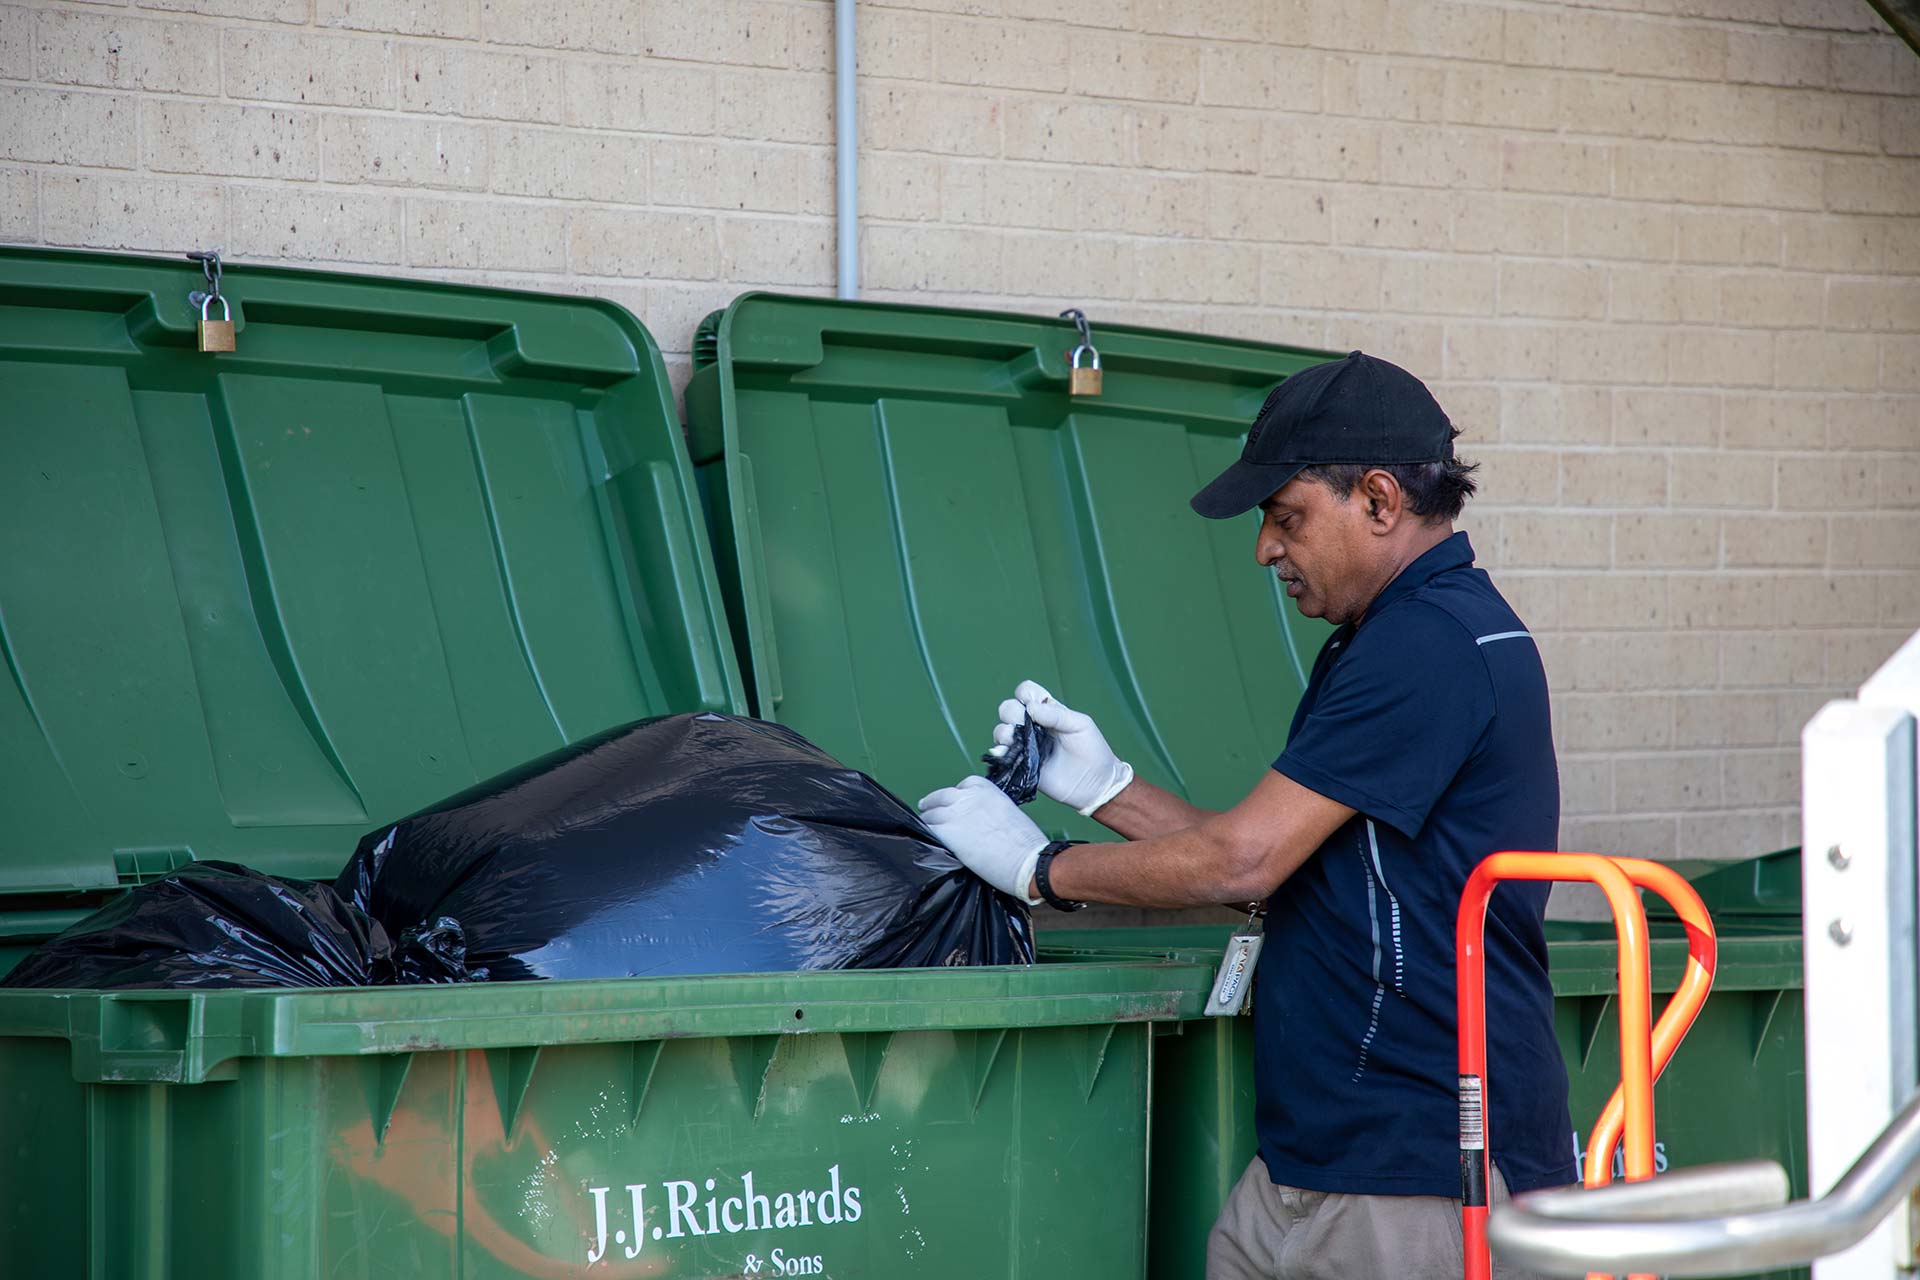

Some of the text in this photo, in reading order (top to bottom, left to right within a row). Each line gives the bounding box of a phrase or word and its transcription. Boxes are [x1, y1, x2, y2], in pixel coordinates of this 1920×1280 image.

[587, 1164, 862, 1263] J.J.Richards
[744, 1248, 823, 1277] & Sons
